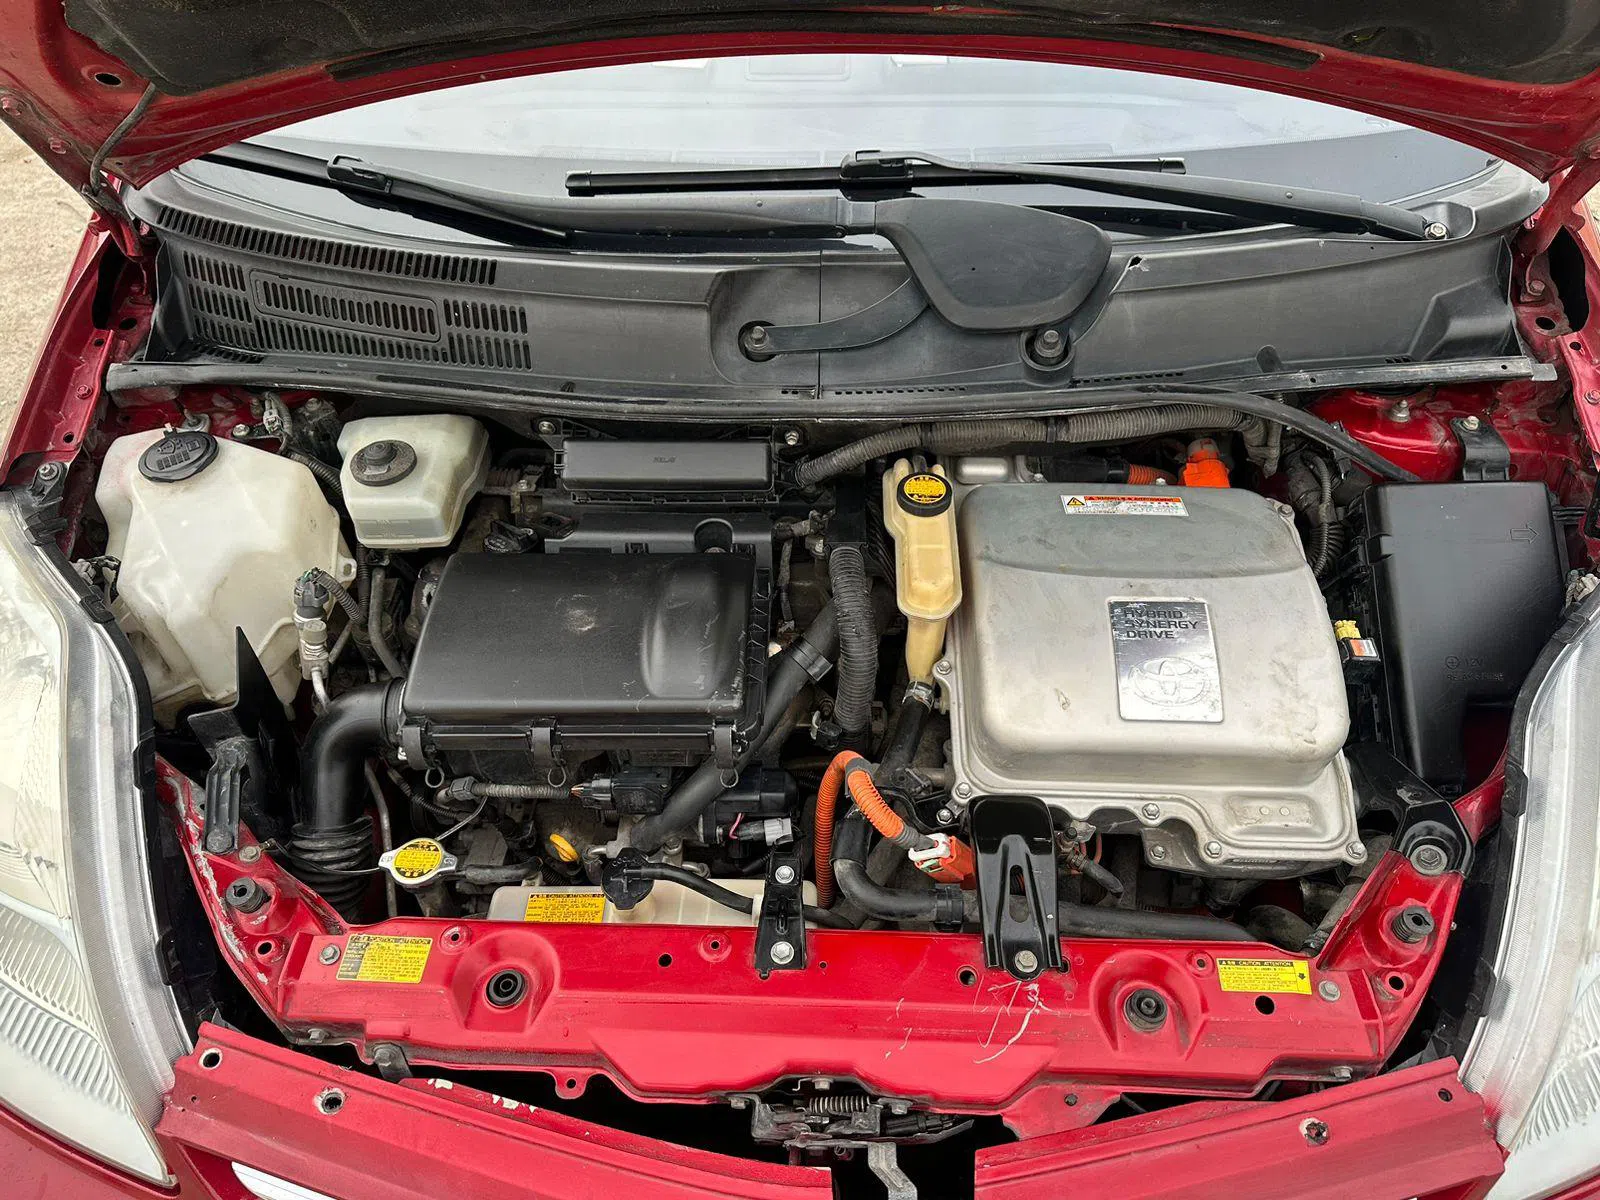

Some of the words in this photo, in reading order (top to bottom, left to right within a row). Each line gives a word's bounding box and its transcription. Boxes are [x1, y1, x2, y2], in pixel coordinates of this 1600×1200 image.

[1125, 609, 1183, 619] HYBRID
[1125, 620, 1199, 630] SYNERGY
[1126, 630, 1175, 639] DRIVE
